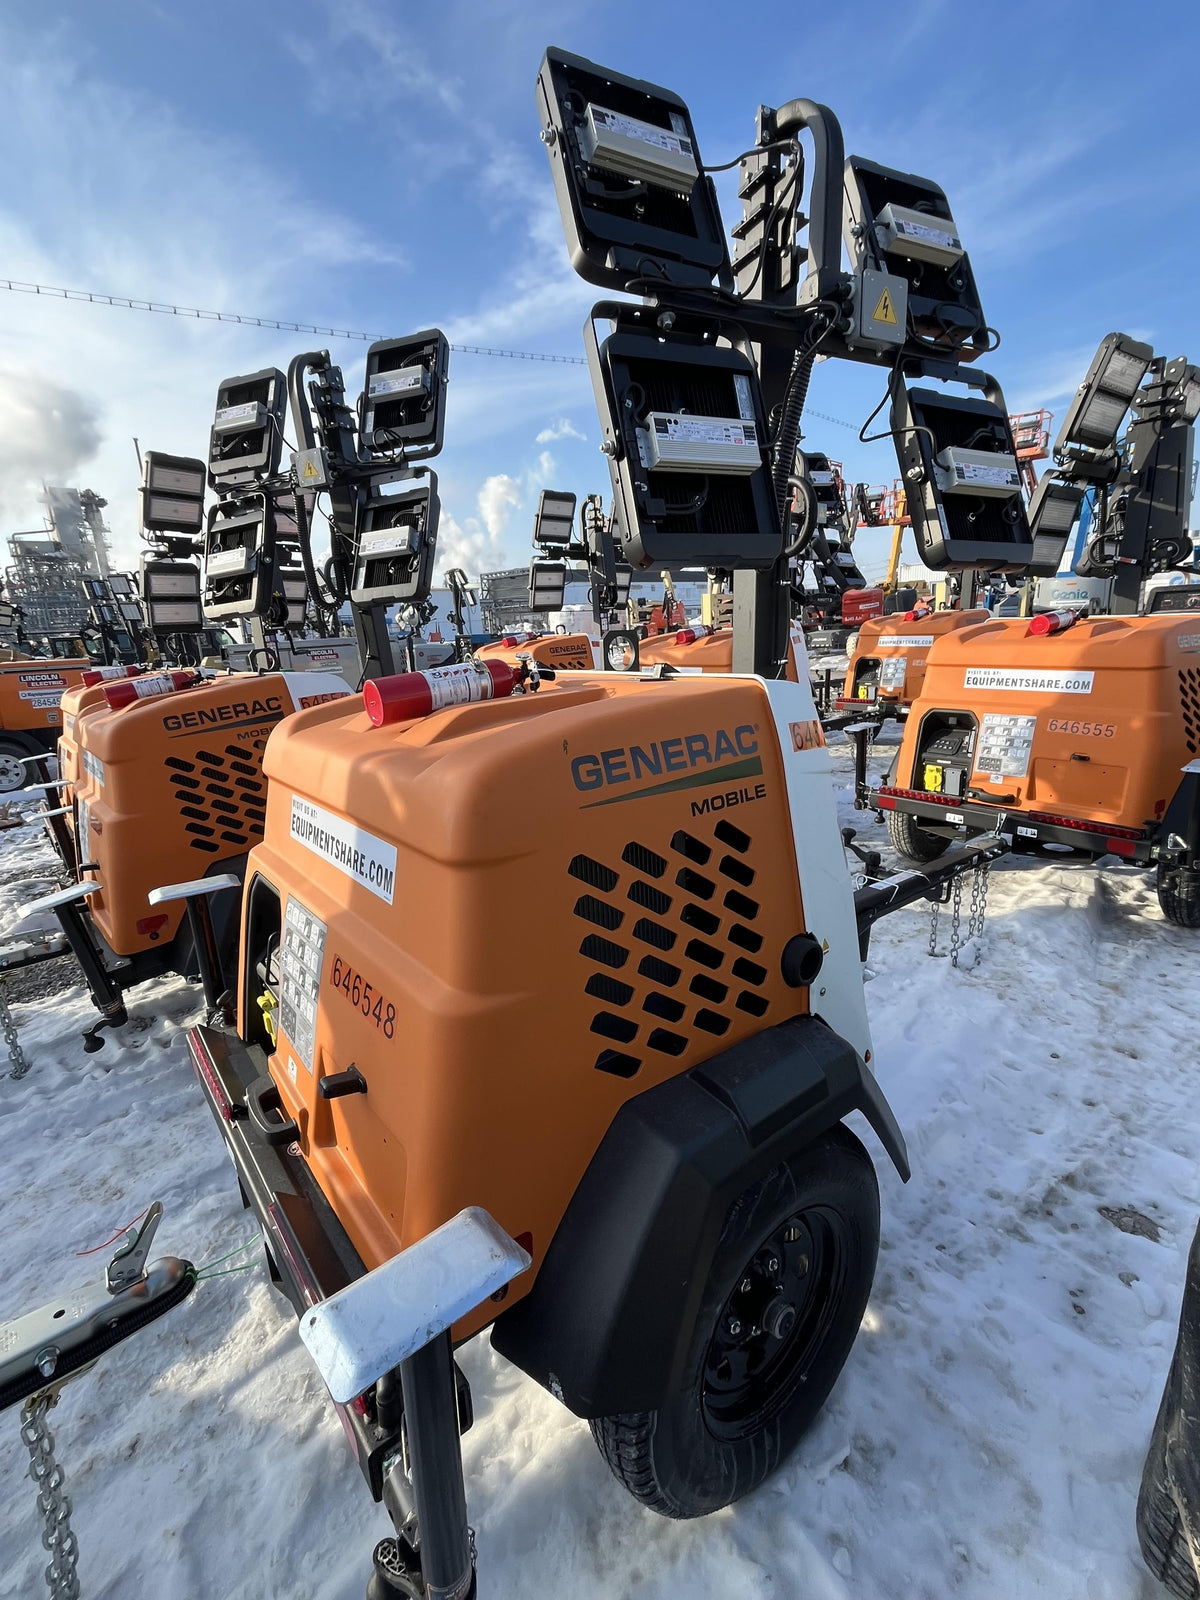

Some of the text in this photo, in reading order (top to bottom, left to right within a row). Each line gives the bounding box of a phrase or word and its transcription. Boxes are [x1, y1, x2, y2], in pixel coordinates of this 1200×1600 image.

[1052, 588, 1089, 600] Genie
[549, 643, 586, 654] GENERAC
[20, 674, 59, 682] LINCOLN
[966, 676, 1091, 691] EQUIPMENTSHARE.COM
[301, 691, 351, 709] 6465
[163, 696, 283, 732] GENERAC
[1049, 719, 1115, 738] 646555
[570, 724, 760, 792] GENERAC
[293, 799, 304, 812] VISIT
[691, 784, 767, 817] MOBILE
[291, 813, 394, 895] EQUIPMENTSHARE.COM
[333, 957, 396, 1039] 646548
